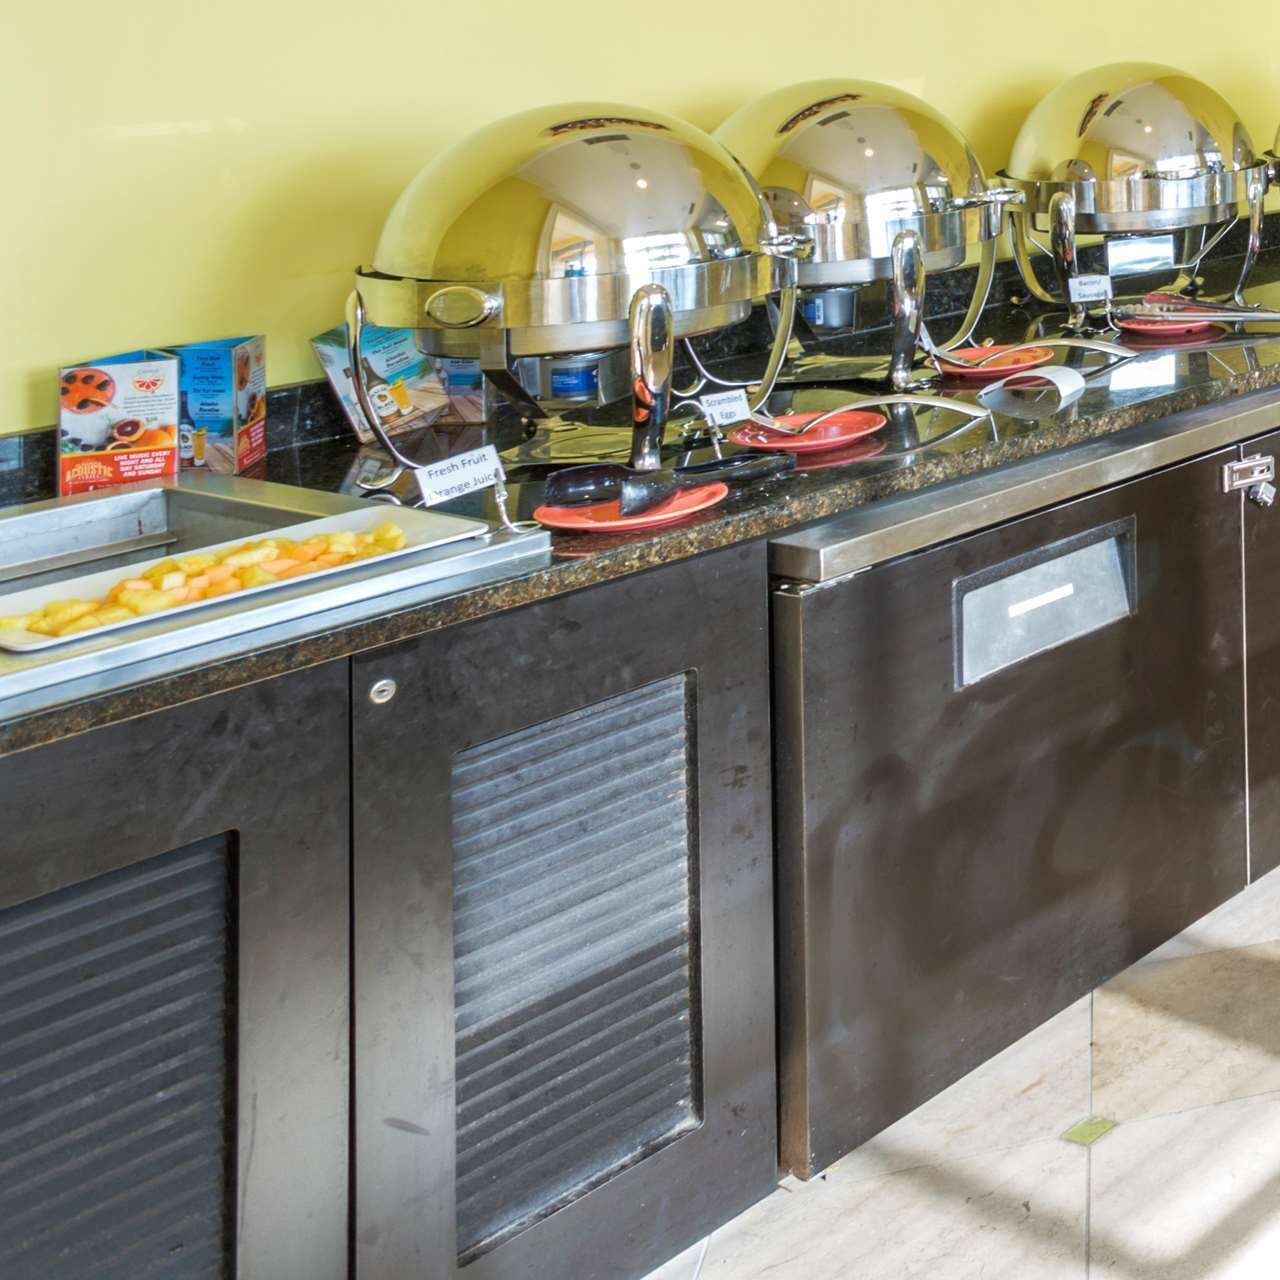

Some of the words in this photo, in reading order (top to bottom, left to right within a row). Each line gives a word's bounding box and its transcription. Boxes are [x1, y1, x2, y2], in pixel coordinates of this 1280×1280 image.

[427, 462, 459, 480] Fresh
[461, 453, 488, 470] Fruit
[430, 481, 471, 500] range
